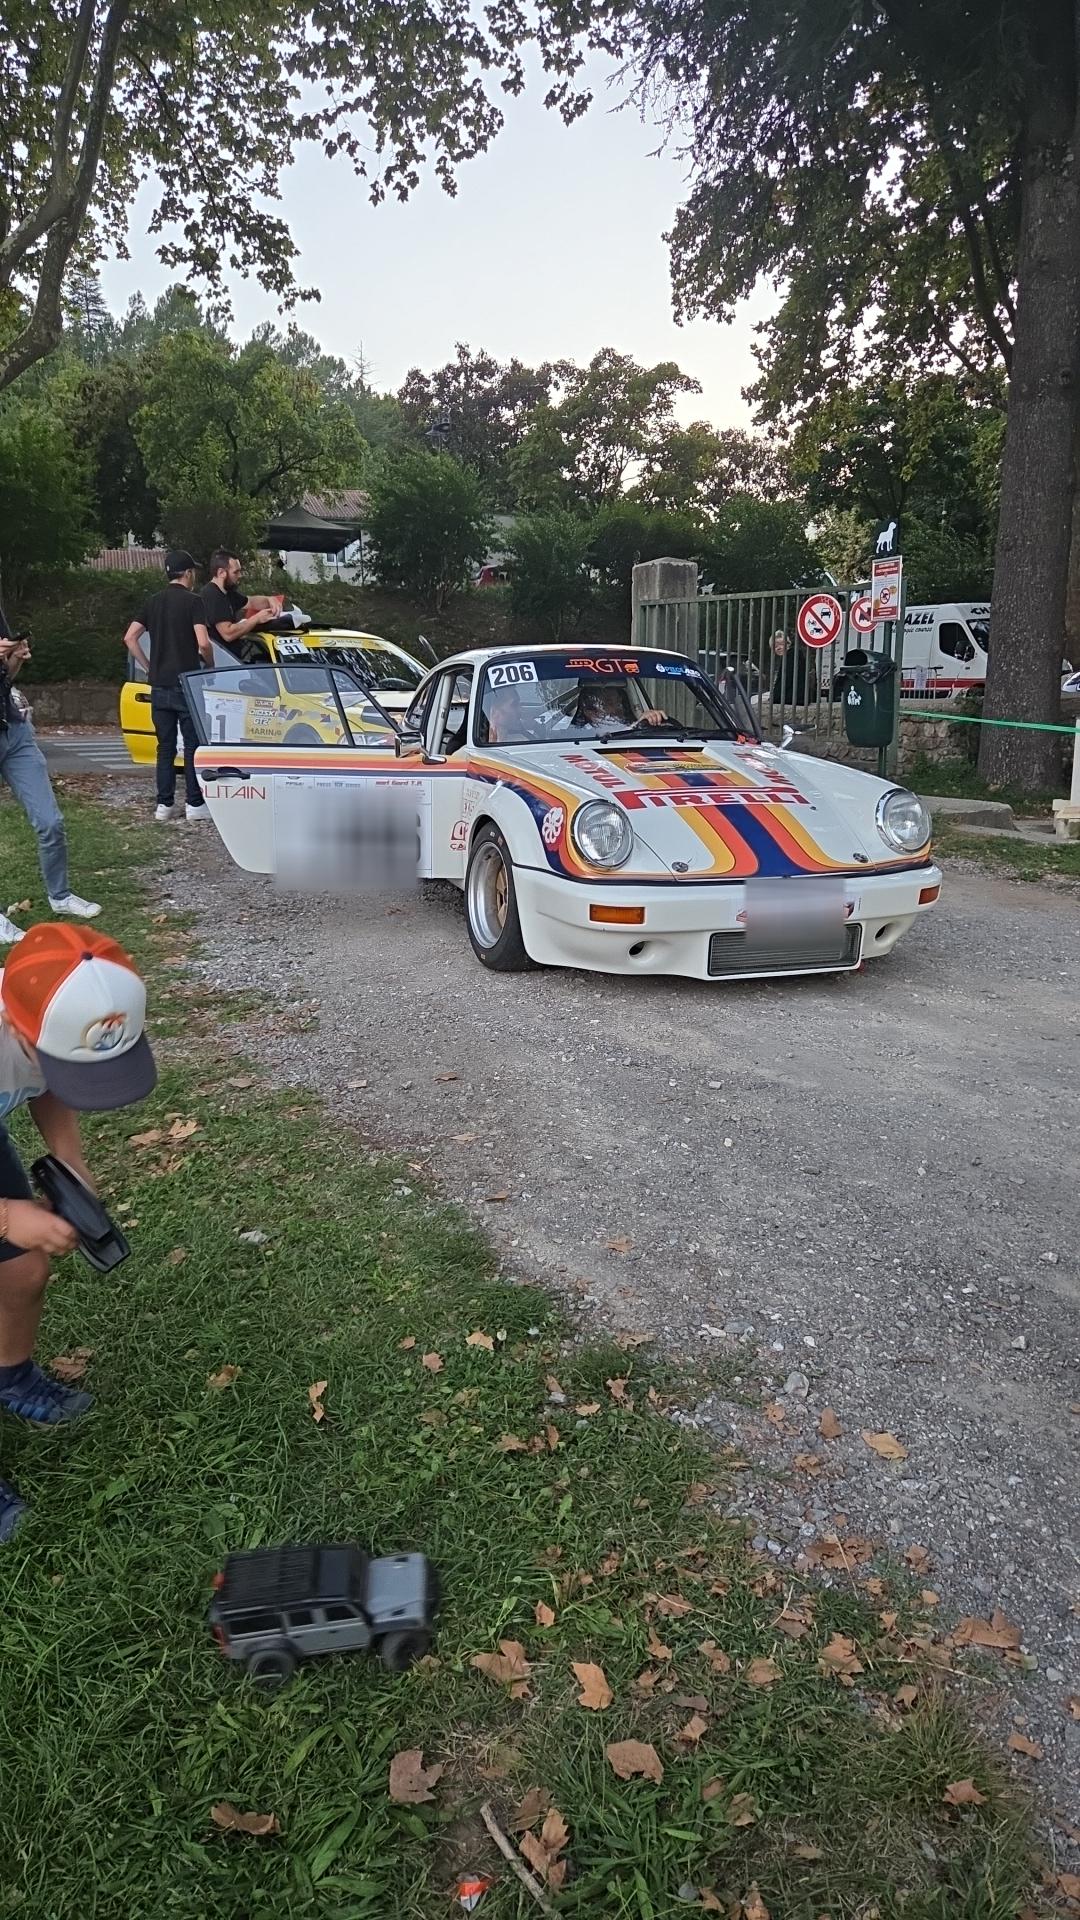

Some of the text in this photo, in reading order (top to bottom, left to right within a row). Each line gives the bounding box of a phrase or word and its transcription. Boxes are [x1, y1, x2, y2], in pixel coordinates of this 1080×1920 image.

[904, 612, 935, 625] AZEL
[285, 645, 301, 653] 91
[491, 664, 535, 687] 206
[559, 754, 628, 789] MOTUL
[203, 785, 266, 800] LITAIN
[612, 786, 811, 810] PIRELLI
